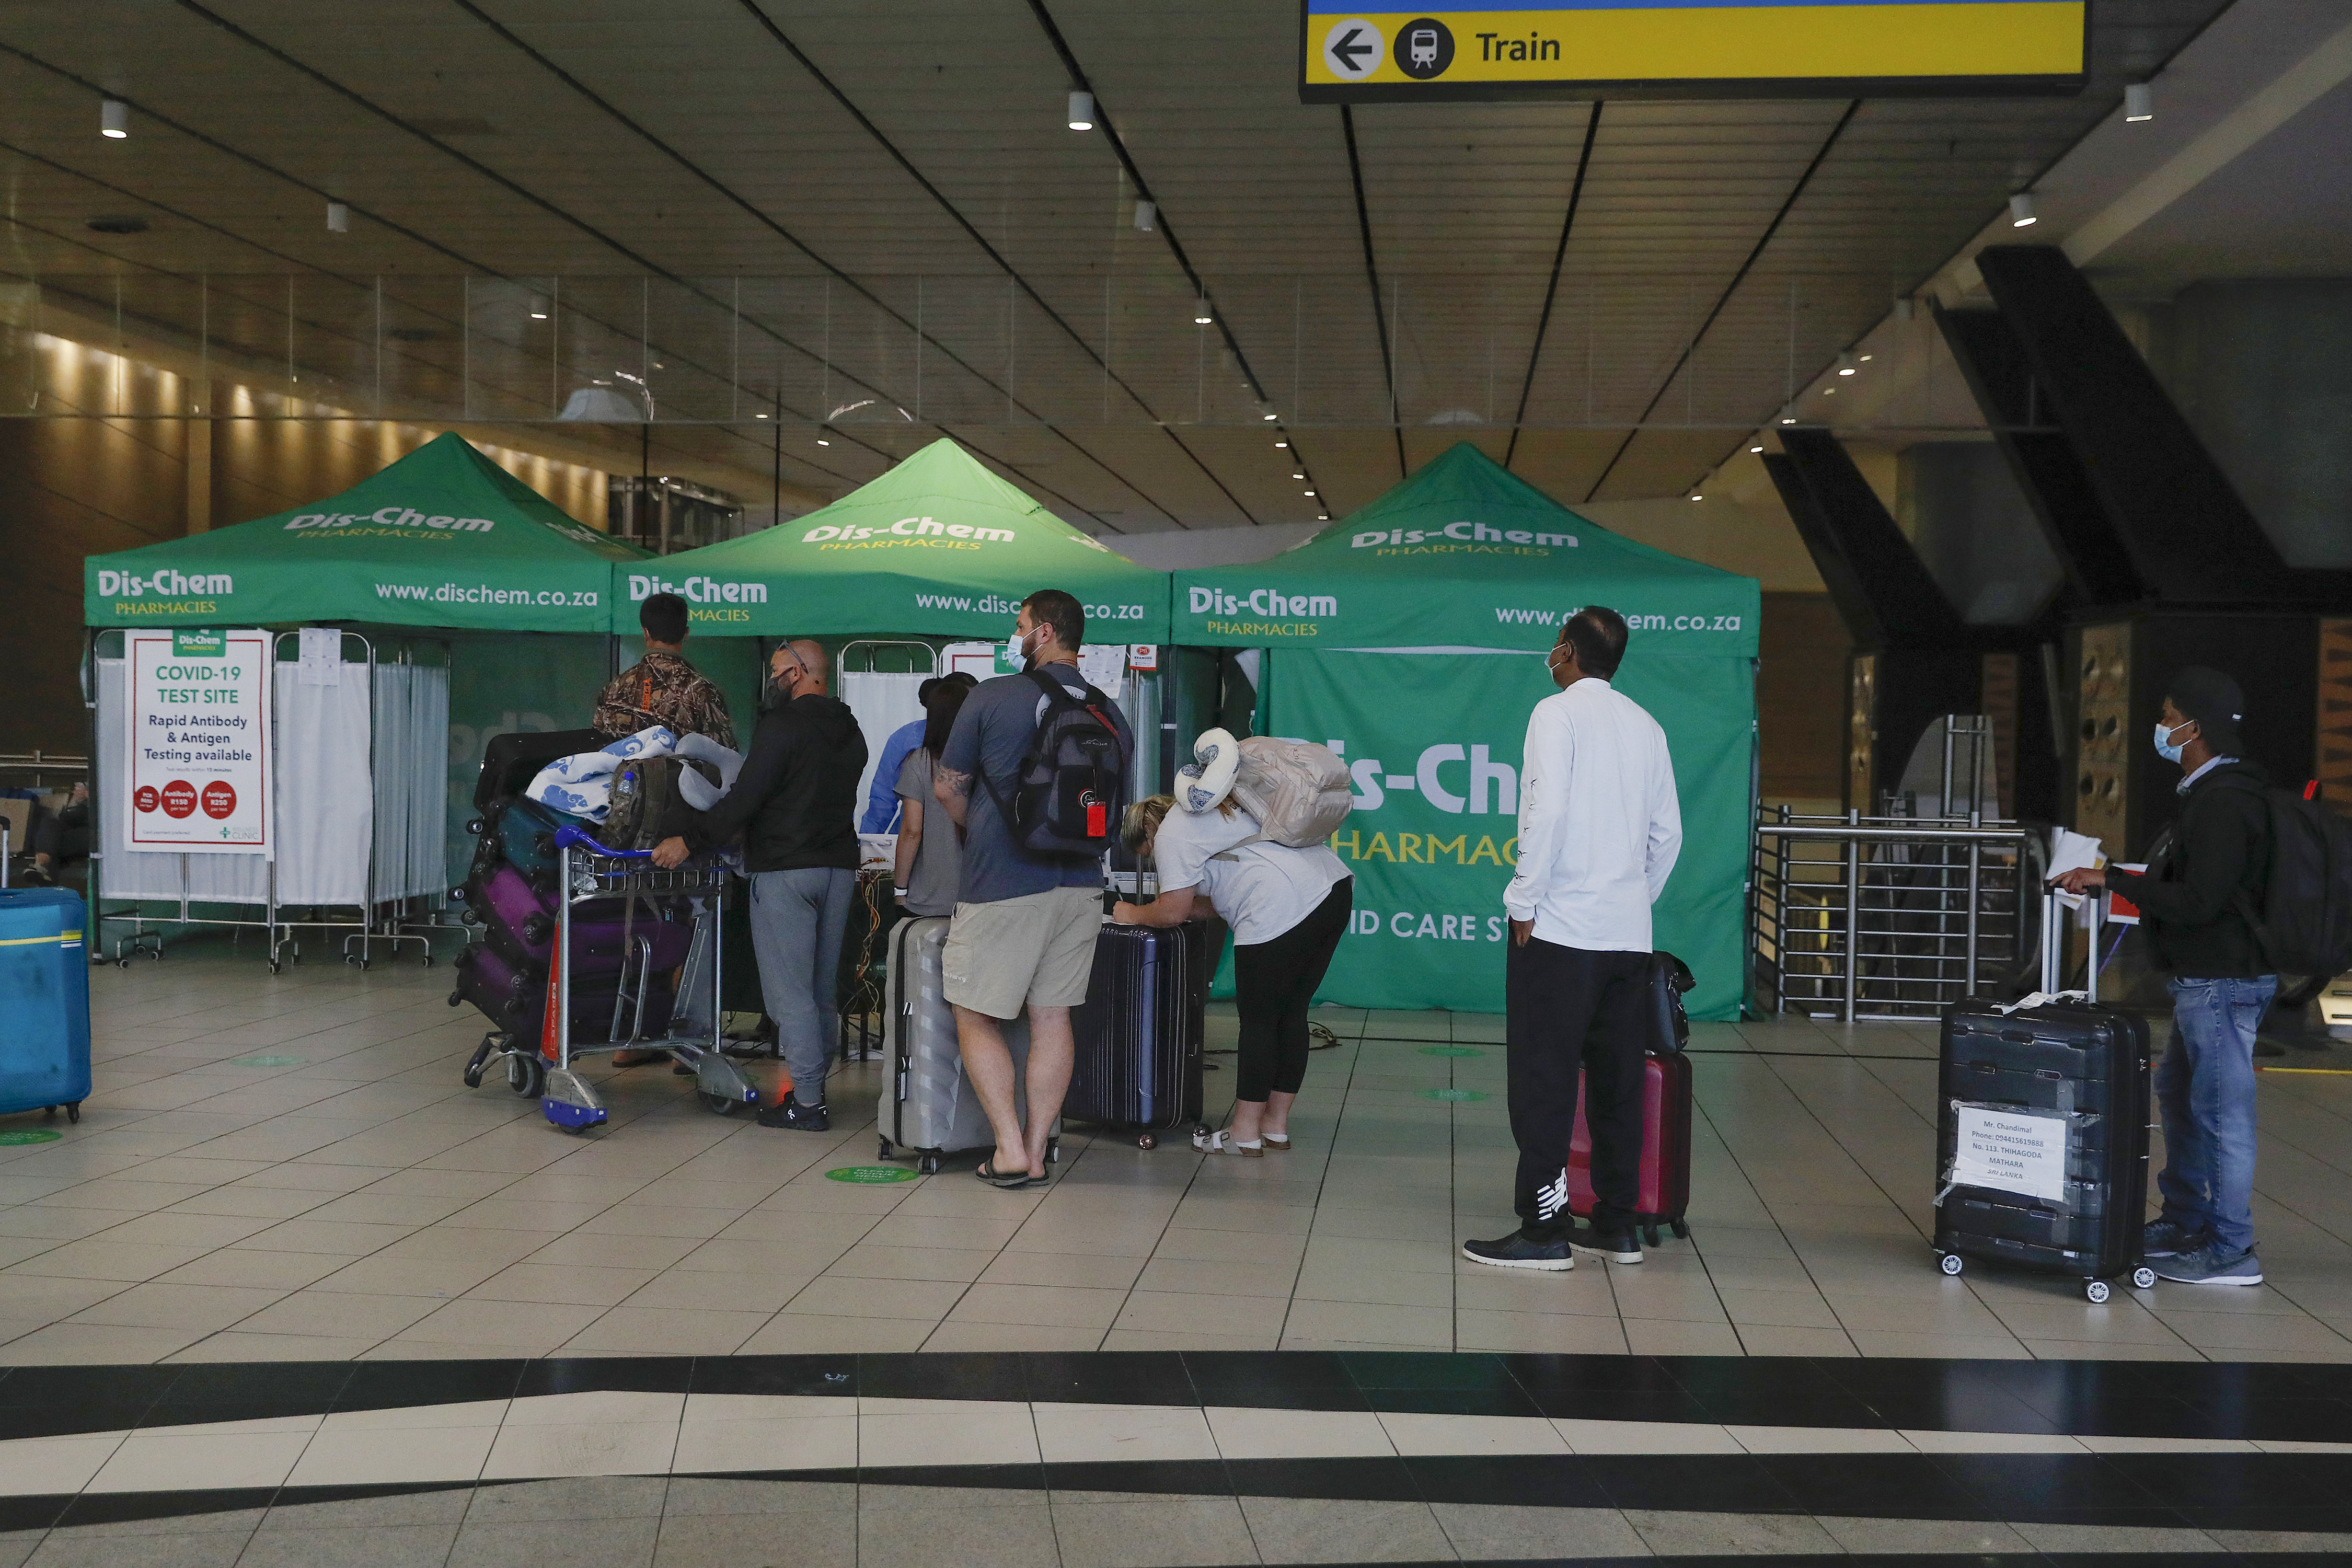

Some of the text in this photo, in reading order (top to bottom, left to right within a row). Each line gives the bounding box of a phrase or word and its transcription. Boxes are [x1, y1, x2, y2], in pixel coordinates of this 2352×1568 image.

[1475, 31, 1560, 61] Train
[283, 506, 494, 532] Dis-Chem
[296, 528, 456, 539] PHARMACIES
[802, 516, 1016, 543] Dis-Chem
[1351, 521, 1578, 549] Dis-Chem
[820, 539, 981, 551] PHARMACIES
[1377, 544, 1550, 557] PHARMACIES
[98, 570, 233, 596] Dis-Chem
[375, 583, 598, 607] www.dischem.co.za
[1189, 586, 1337, 617] Dis-Chem
[115, 601, 216, 615] PHARMACIES
[915, 593, 1144, 620] www.discco.za
[688, 609, 750, 622] MACIES
[1207, 621, 1317, 637] PHARMACIES
[156, 666, 241, 681] COVID-19
[157, 689, 238, 704] TEST SITE
[149, 715, 247, 730] Rapid Antibody
[167, 732, 230, 746] & Antigen
[144, 748, 252, 763] Testing available
[1390, 912, 1475, 941] CARE
[1971, 1131, 1994, 1140] Phone:
[1997, 1123, 2032, 1134] Chandimal
[2001, 1147, 2042, 1159] THIHAGODA
[1989, 1157, 2024, 1169] MATHARA
[2000, 1171, 2023, 1180] LANKA
